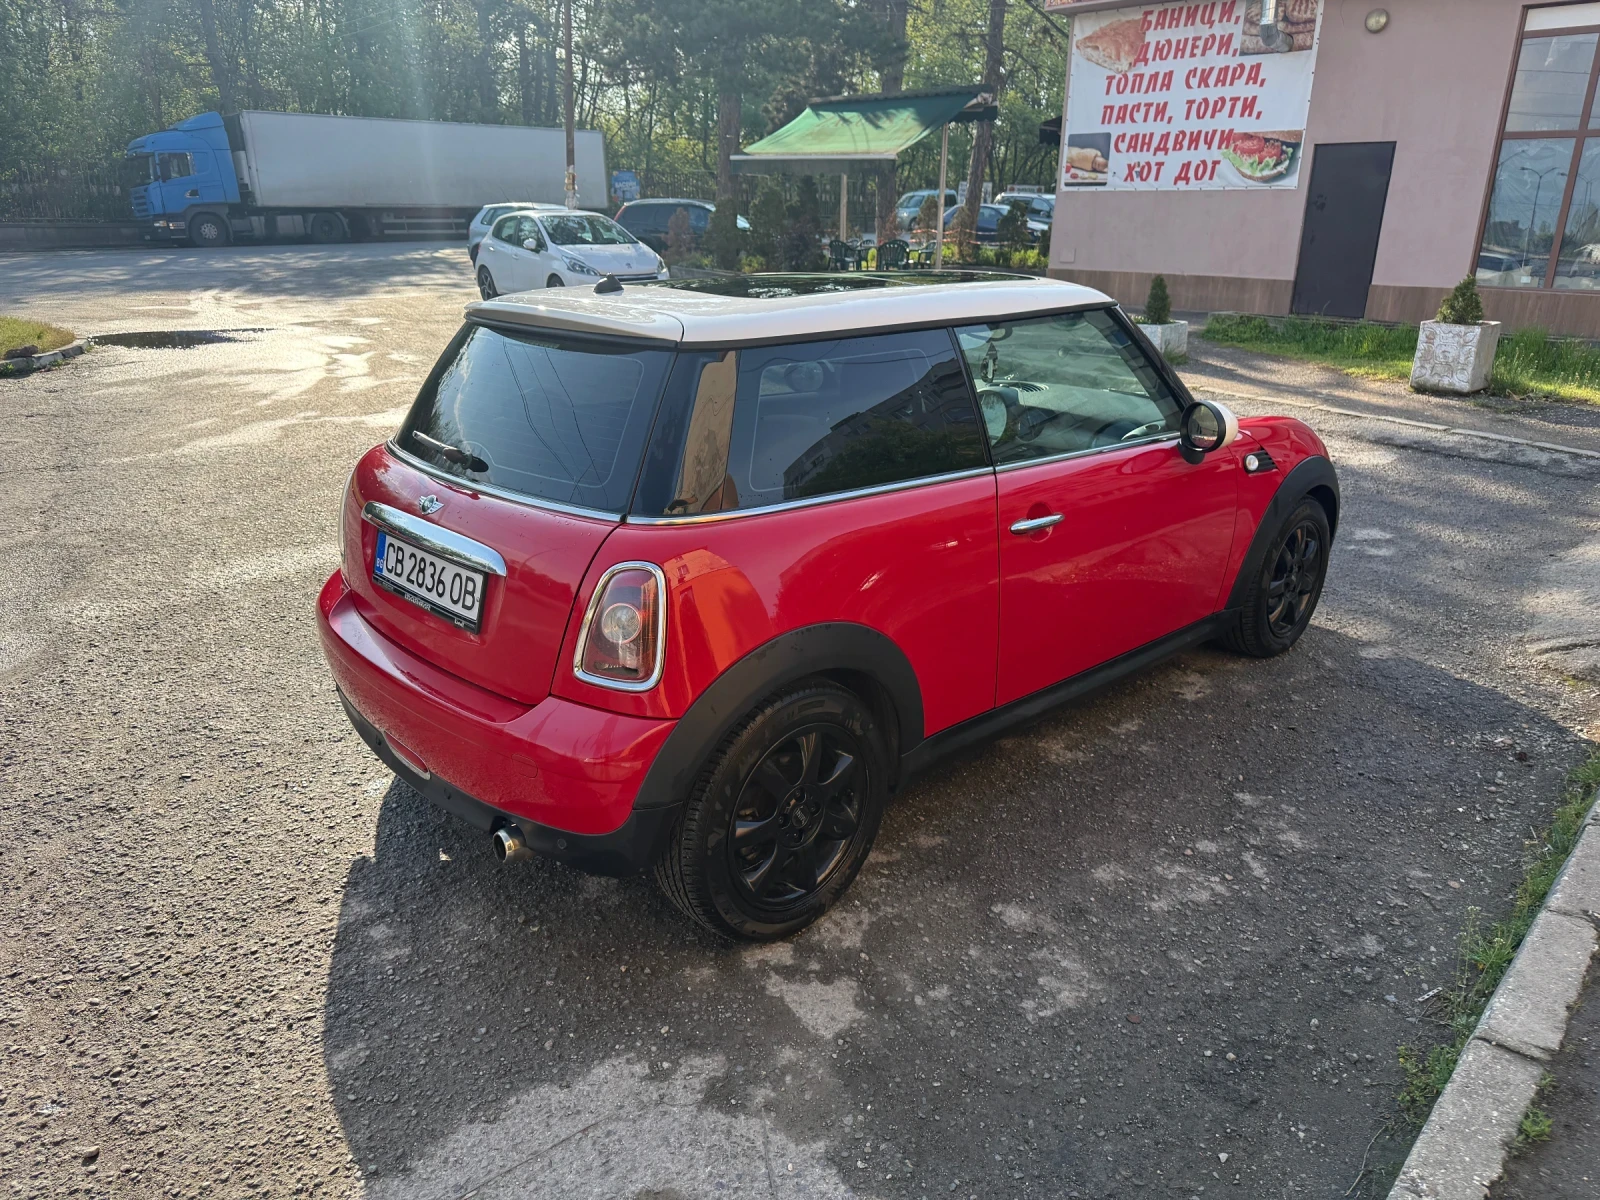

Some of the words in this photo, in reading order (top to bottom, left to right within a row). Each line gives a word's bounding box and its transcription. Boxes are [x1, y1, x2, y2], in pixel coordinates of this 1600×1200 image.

[1139, 0, 1242, 33] БАНИЦИ,
[1132, 32, 1240, 68] ДЮНЕРИ,
[1105, 69, 1175, 96] ТОПЛА
[1184, 62, 1267, 90] СКАРА,
[1101, 101, 1173, 125] ПАСТИ,
[1184, 95, 1263, 121] ТОРТИ,
[1113, 128, 1239, 156] САНДВИЧИ,
[1123, 161, 1165, 183] ХОТ
[1173, 159, 1222, 186] ДОГ
[385, 542, 405, 578] CB
[406, 552, 447, 598] 2836
[450, 572, 477, 611] OB
